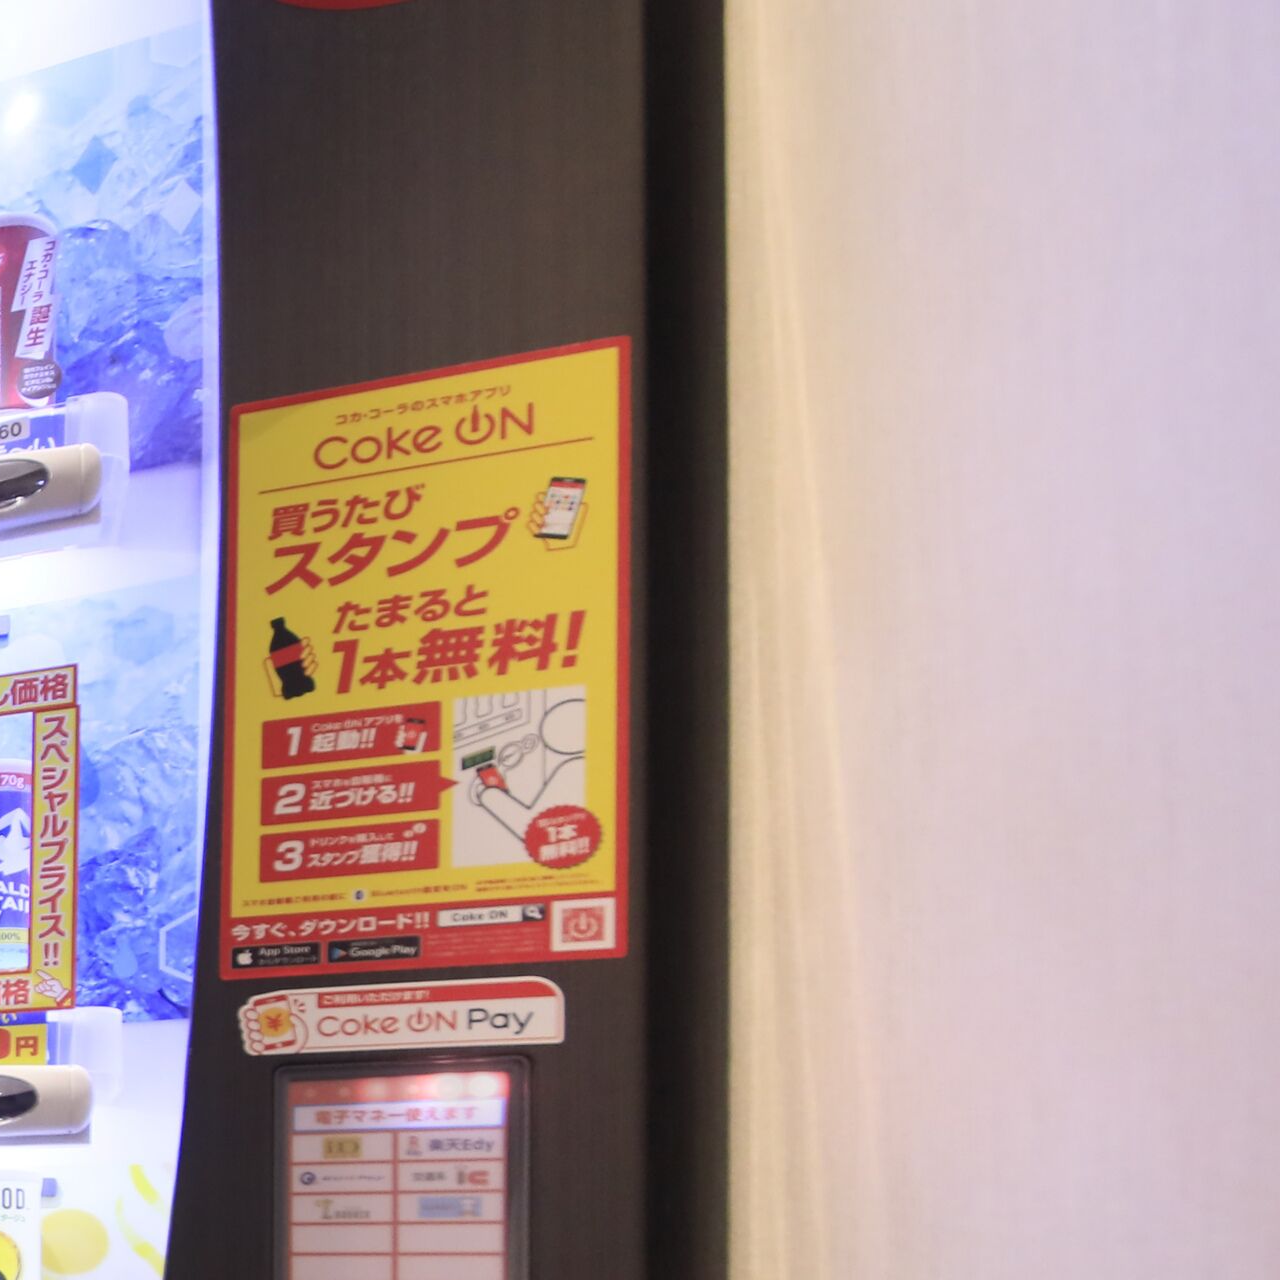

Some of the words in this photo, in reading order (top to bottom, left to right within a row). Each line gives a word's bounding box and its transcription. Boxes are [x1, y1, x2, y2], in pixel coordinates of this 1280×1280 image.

[26, 304, 51, 348] 誕生
[335, 385, 512, 427] コカ・コーラのスマホアプリ
[313, 425, 444, 471] Coke
[454, 402, 535, 446] ON
[268, 483, 426, 541] 買うたび
[265, 506, 520, 596] スタンプ
[332, 584, 489, 635] たまると
[331, 610, 587, 695] 1本無料!
[287, 726, 302, 756] 1
[311, 728, 377, 753] 起動!!
[273, 783, 306, 815] 2
[308, 782, 416, 811] 近づける!!
[273, 840, 305, 872] 3
[231, 912, 430, 941] 今すぐ、ダウンロード!!
[259, 947, 280, 958] App
[283, 945, 311, 954] Store
[349, 946, 391, 958] Google
[392, 944, 417, 957] Play
[317, 1012, 399, 1038] Coke
[407, 1007, 457, 1033] ON
[467, 1007, 534, 1035] Pay
